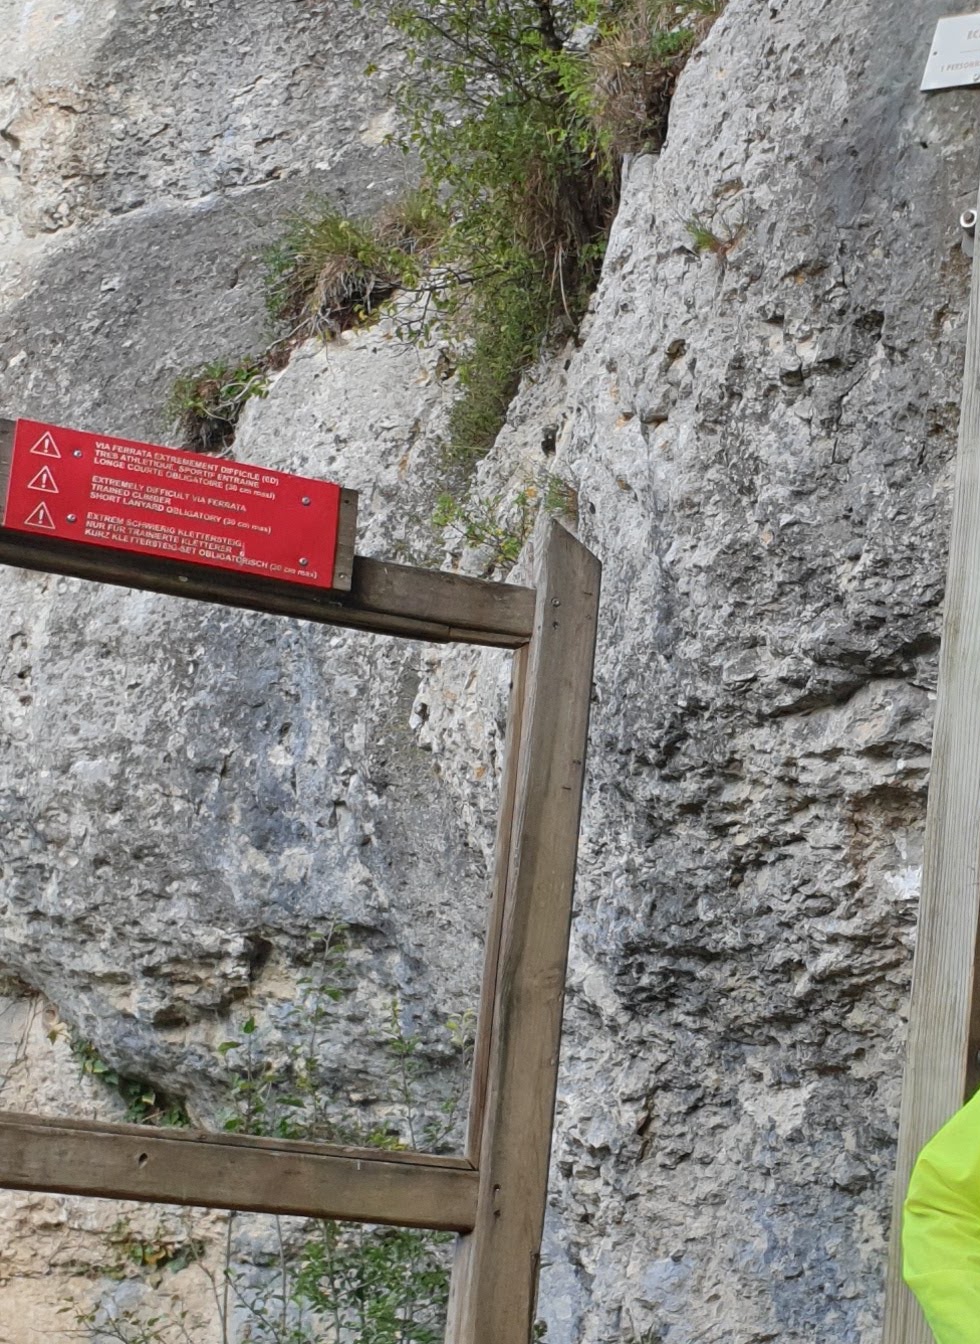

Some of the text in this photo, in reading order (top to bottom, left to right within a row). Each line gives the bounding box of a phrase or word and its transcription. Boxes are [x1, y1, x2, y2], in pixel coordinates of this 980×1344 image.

[93, 457, 125, 469] LONGE
[127, 463, 163, 477] COURTE
[165, 470, 223, 488] OBLIGATOIRE
[95, 441, 110, 451] VIA
[112, 444, 152, 458] FERRATA
[154, 452, 219, 471] EXTREMEMENT
[221, 466, 259, 481] DIFFICILE
[178, 465, 215, 478] SPORTIF
[90, 491, 121, 503] SHORT
[122, 498, 164, 512] LANYARD
[166, 506, 222, 522] OBLIGATORY
[91, 483, 171, 505] TRAINED CLIMBER
[92, 475, 247, 512] EXTREMELY DIFFICULT VIA FERRATA
[86, 511, 242, 547] EXTREM SCHWIERIG KLETTERSTEIG
[86, 520, 105, 530] NUR
[128, 527, 179, 543] TRAINIERTE
[181, 538, 232, 553] KLETTERER
[84, 528, 110, 539] KURZ
[198, 550, 269, 568] OBLIGATORISCH
